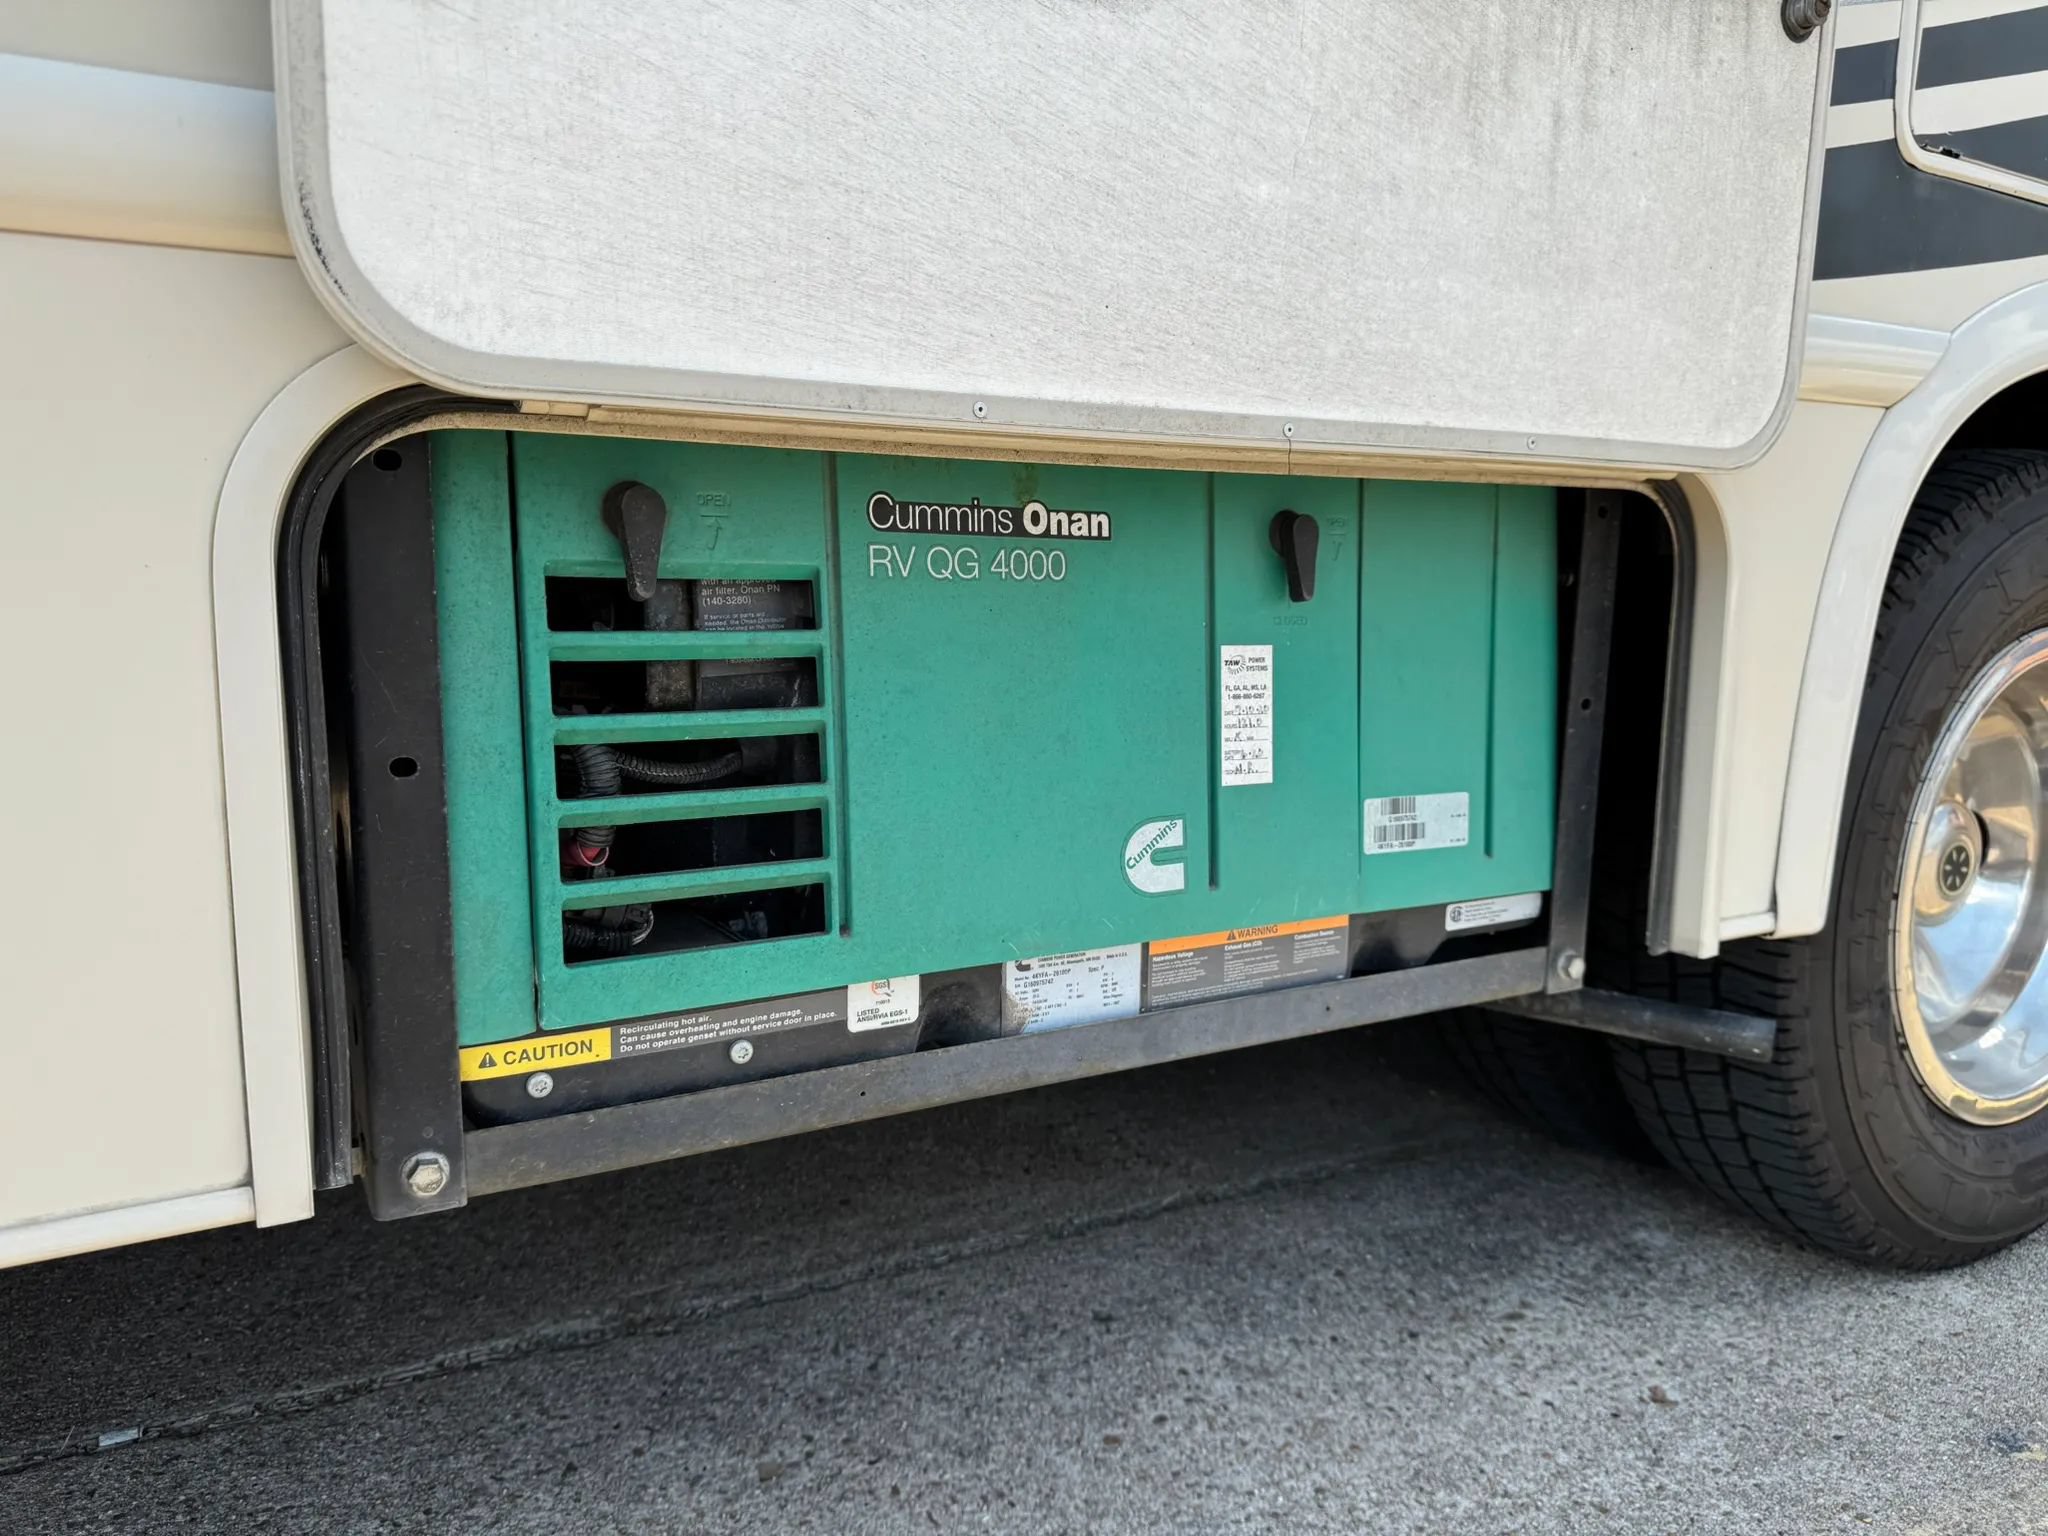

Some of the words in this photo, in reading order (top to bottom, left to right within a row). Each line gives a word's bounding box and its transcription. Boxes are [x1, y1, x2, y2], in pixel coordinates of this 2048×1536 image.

[868, 493, 1013, 534] Cummins
[1022, 501, 1110, 538] Onan
[869, 544, 916, 577] RV
[927, 546, 980, 580] QG
[990, 549, 1067, 581] 4000
[701, 588, 713, 596] air
[740, 585, 765, 594] Onan
[766, 583, 781, 593] PN
[1126, 819, 1178, 870] Cummins
[1237, 924, 1279, 939] WARNING
[1177, 951, 1194, 959] Voltage
[874, 981, 887, 990] SGS
[856, 1007, 880, 1018] LISTED
[889, 1008, 908, 1018] EGS-1
[620, 1020, 680, 1035] Recirculating
[681, 1017, 696, 1026] hot
[697, 1015, 712, 1023] air.
[620, 1035, 638, 1045] Can
[640, 1031, 667, 1041] cause
[669, 1022, 720, 1037] overheating
[722, 1018, 738, 1028] and
[739, 1015, 768, 1024] engine
[769, 1009, 804, 1020] damage.
[620, 1045, 633, 1053] Do
[635, 1041, 650, 1050] not
[652, 1036, 686, 1048] operate
[687, 1031, 717, 1044] genset
[719, 1025, 751, 1037] without
[752, 1020, 782, 1031] service
[783, 1016, 802, 1025] door
[804, 1014, 812, 1022] in
[813, 1011, 837, 1023] place.
[503, 1038, 593, 1066] CAUTION
